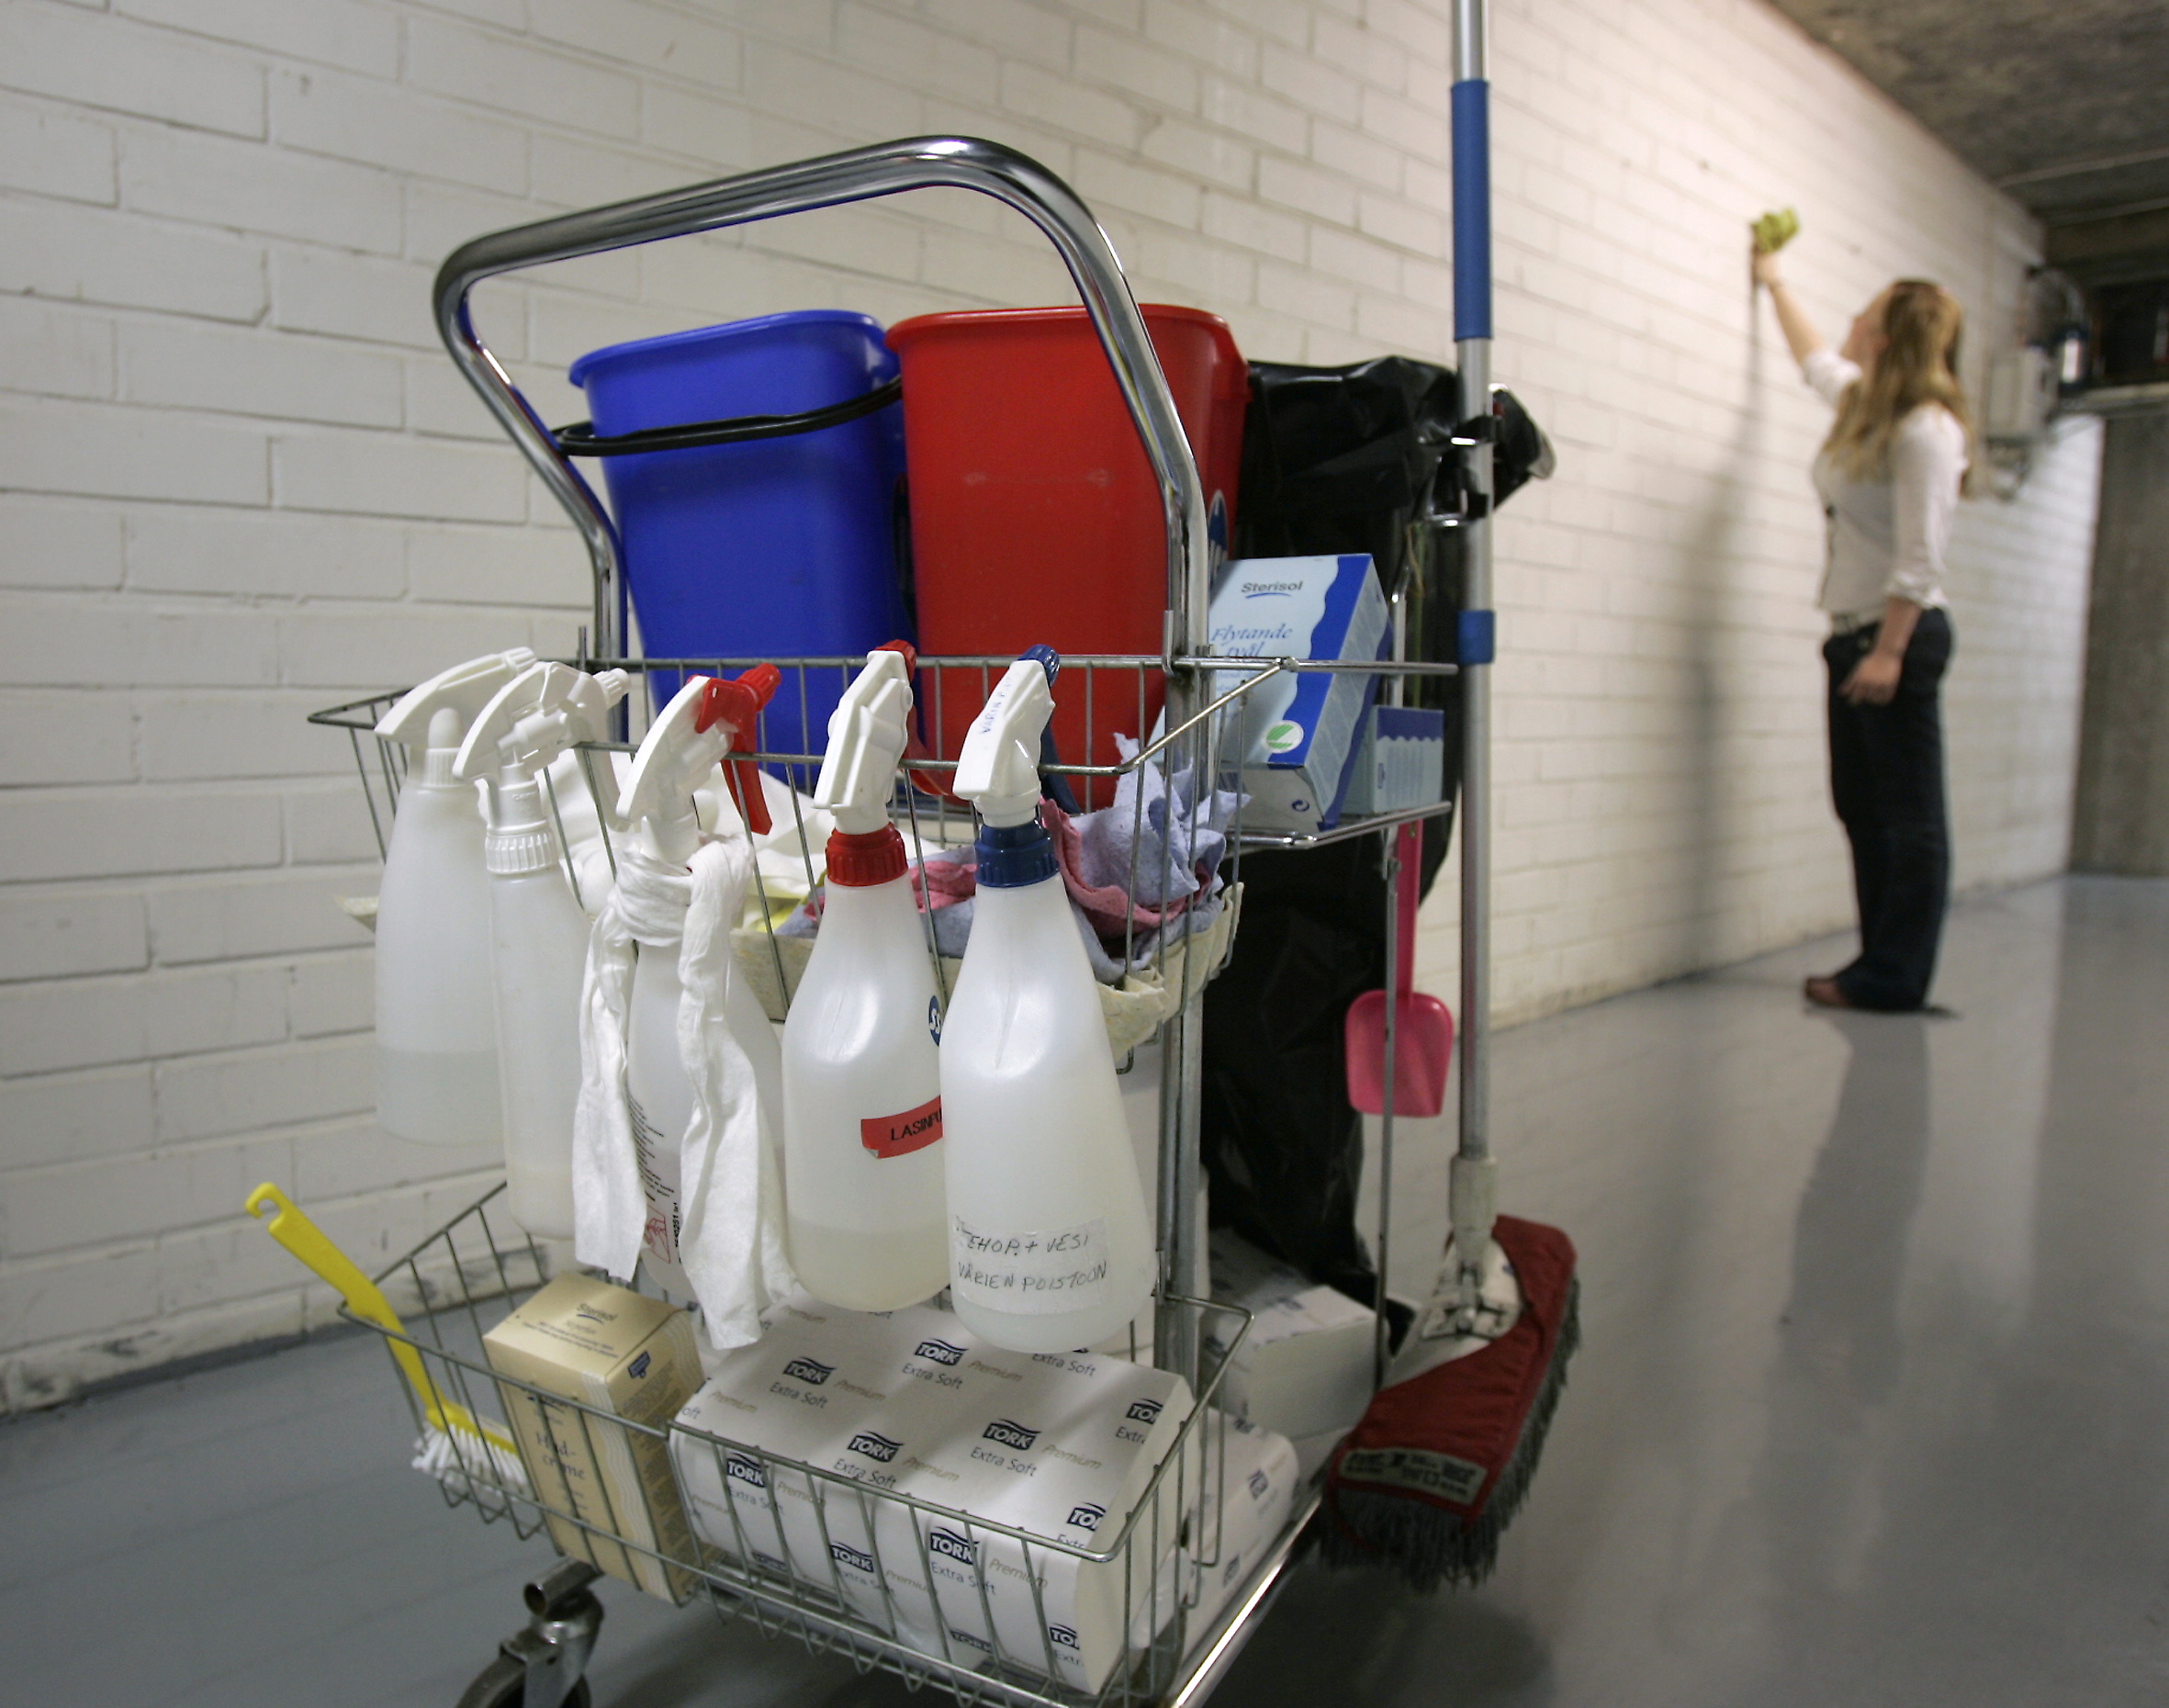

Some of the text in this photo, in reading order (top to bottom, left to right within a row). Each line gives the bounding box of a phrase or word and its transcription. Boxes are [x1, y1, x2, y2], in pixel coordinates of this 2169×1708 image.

[1242, 580, 1303, 593] Sterisol
[1210, 623, 1293, 646] Flytande
[1047, 1233, 1089, 1253] VESI
[917, 1343, 961, 1365] TORK
[784, 1361, 826, 1384] TORK
[902, 1360, 1024, 1390] Extra Soft Premium
[1068, 1360, 1096, 1377] Soft
[770, 1379, 887, 1409] Extra Soft Premium
[682, 1406, 701, 1420] oft
[985, 1424, 1034, 1450] TORK
[1116, 1426, 1146, 1444] Extr
[850, 1436, 896, 1462] TORK
[834, 1455, 961, 1489] Extra Soft Premium
[971, 1444, 1103, 1478] Extra Soft Premium
[727, 1460, 765, 1487] TORK
[831, 1546, 872, 1571] TORK
[931, 1562, 964, 1583] Extra
